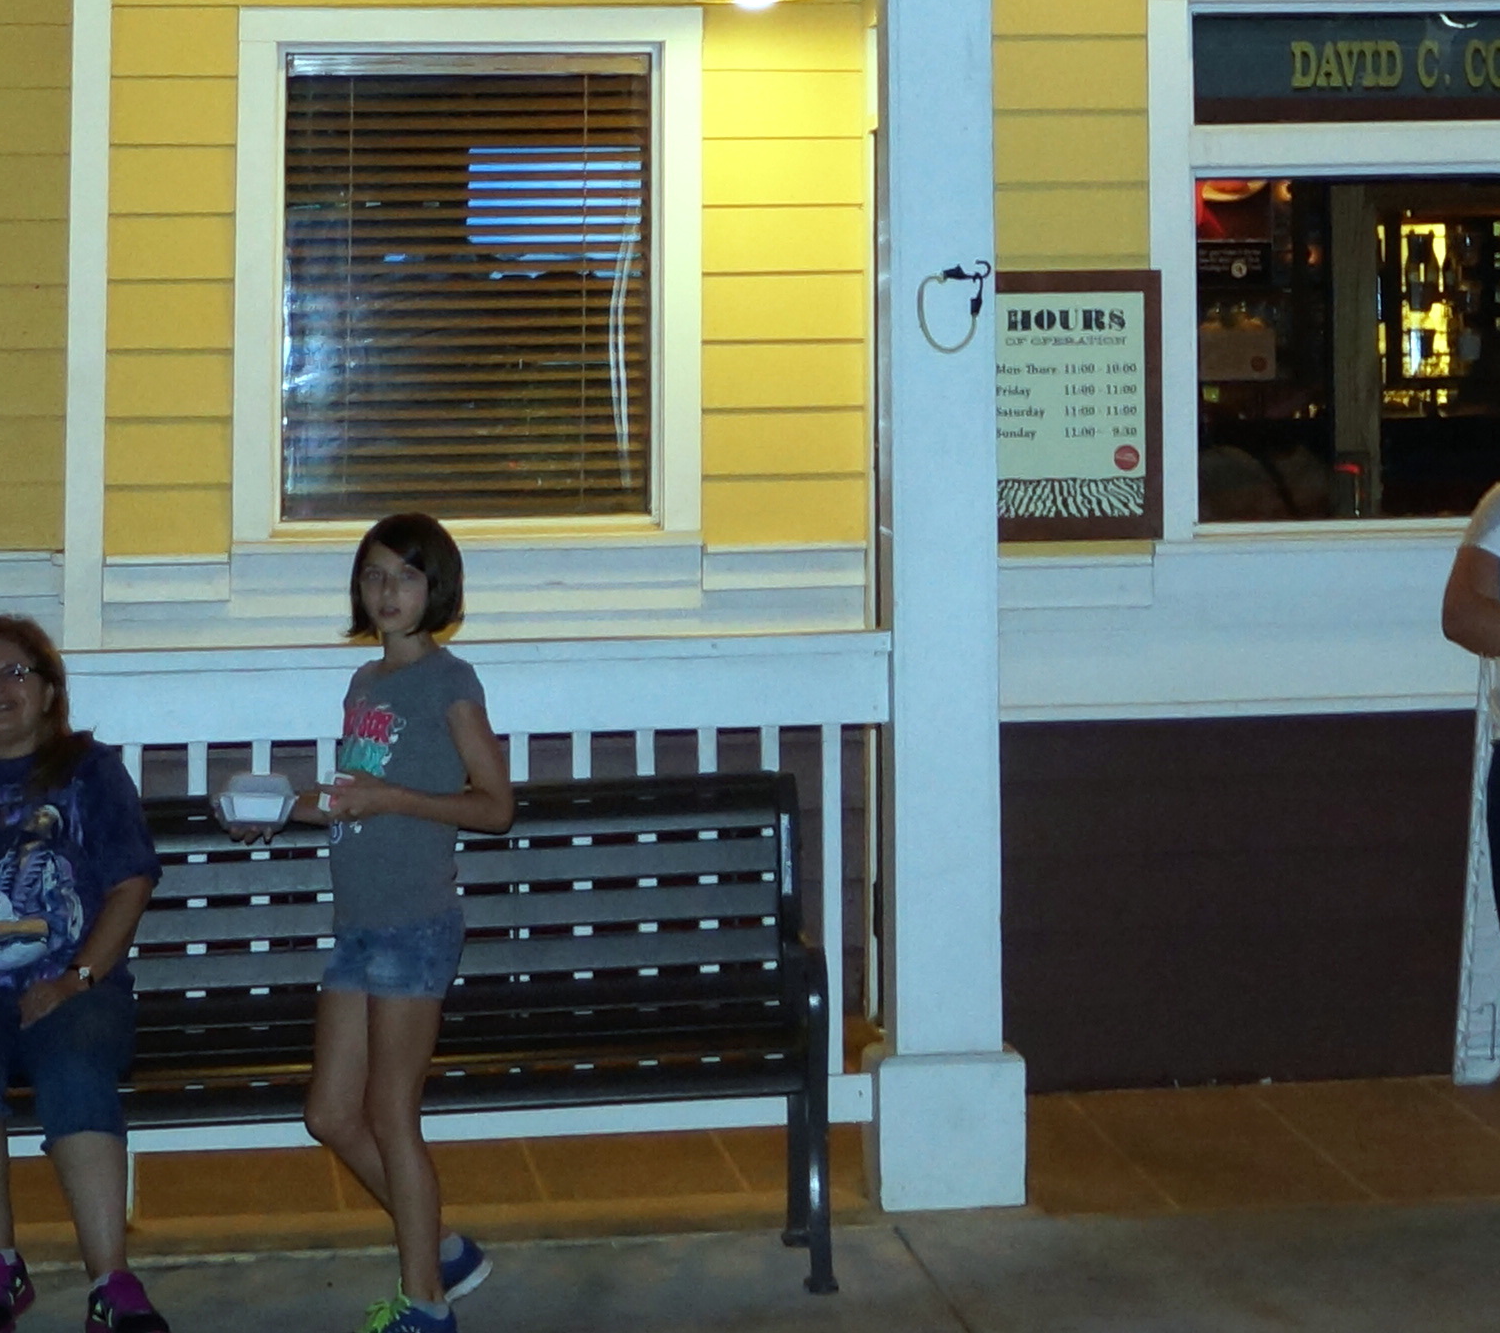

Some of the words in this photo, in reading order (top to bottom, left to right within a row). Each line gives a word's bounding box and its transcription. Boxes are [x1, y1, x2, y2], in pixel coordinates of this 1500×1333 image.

[1290, 39, 1404, 90] DAVID
[1416, 39, 1452, 89] C.
[1006, 308, 1126, 332] HOURS
[1005, 337, 1027, 347] OF
[1030, 336, 1126, 347] OPERATION
[1063, 363, 1096, 374] 11:00
